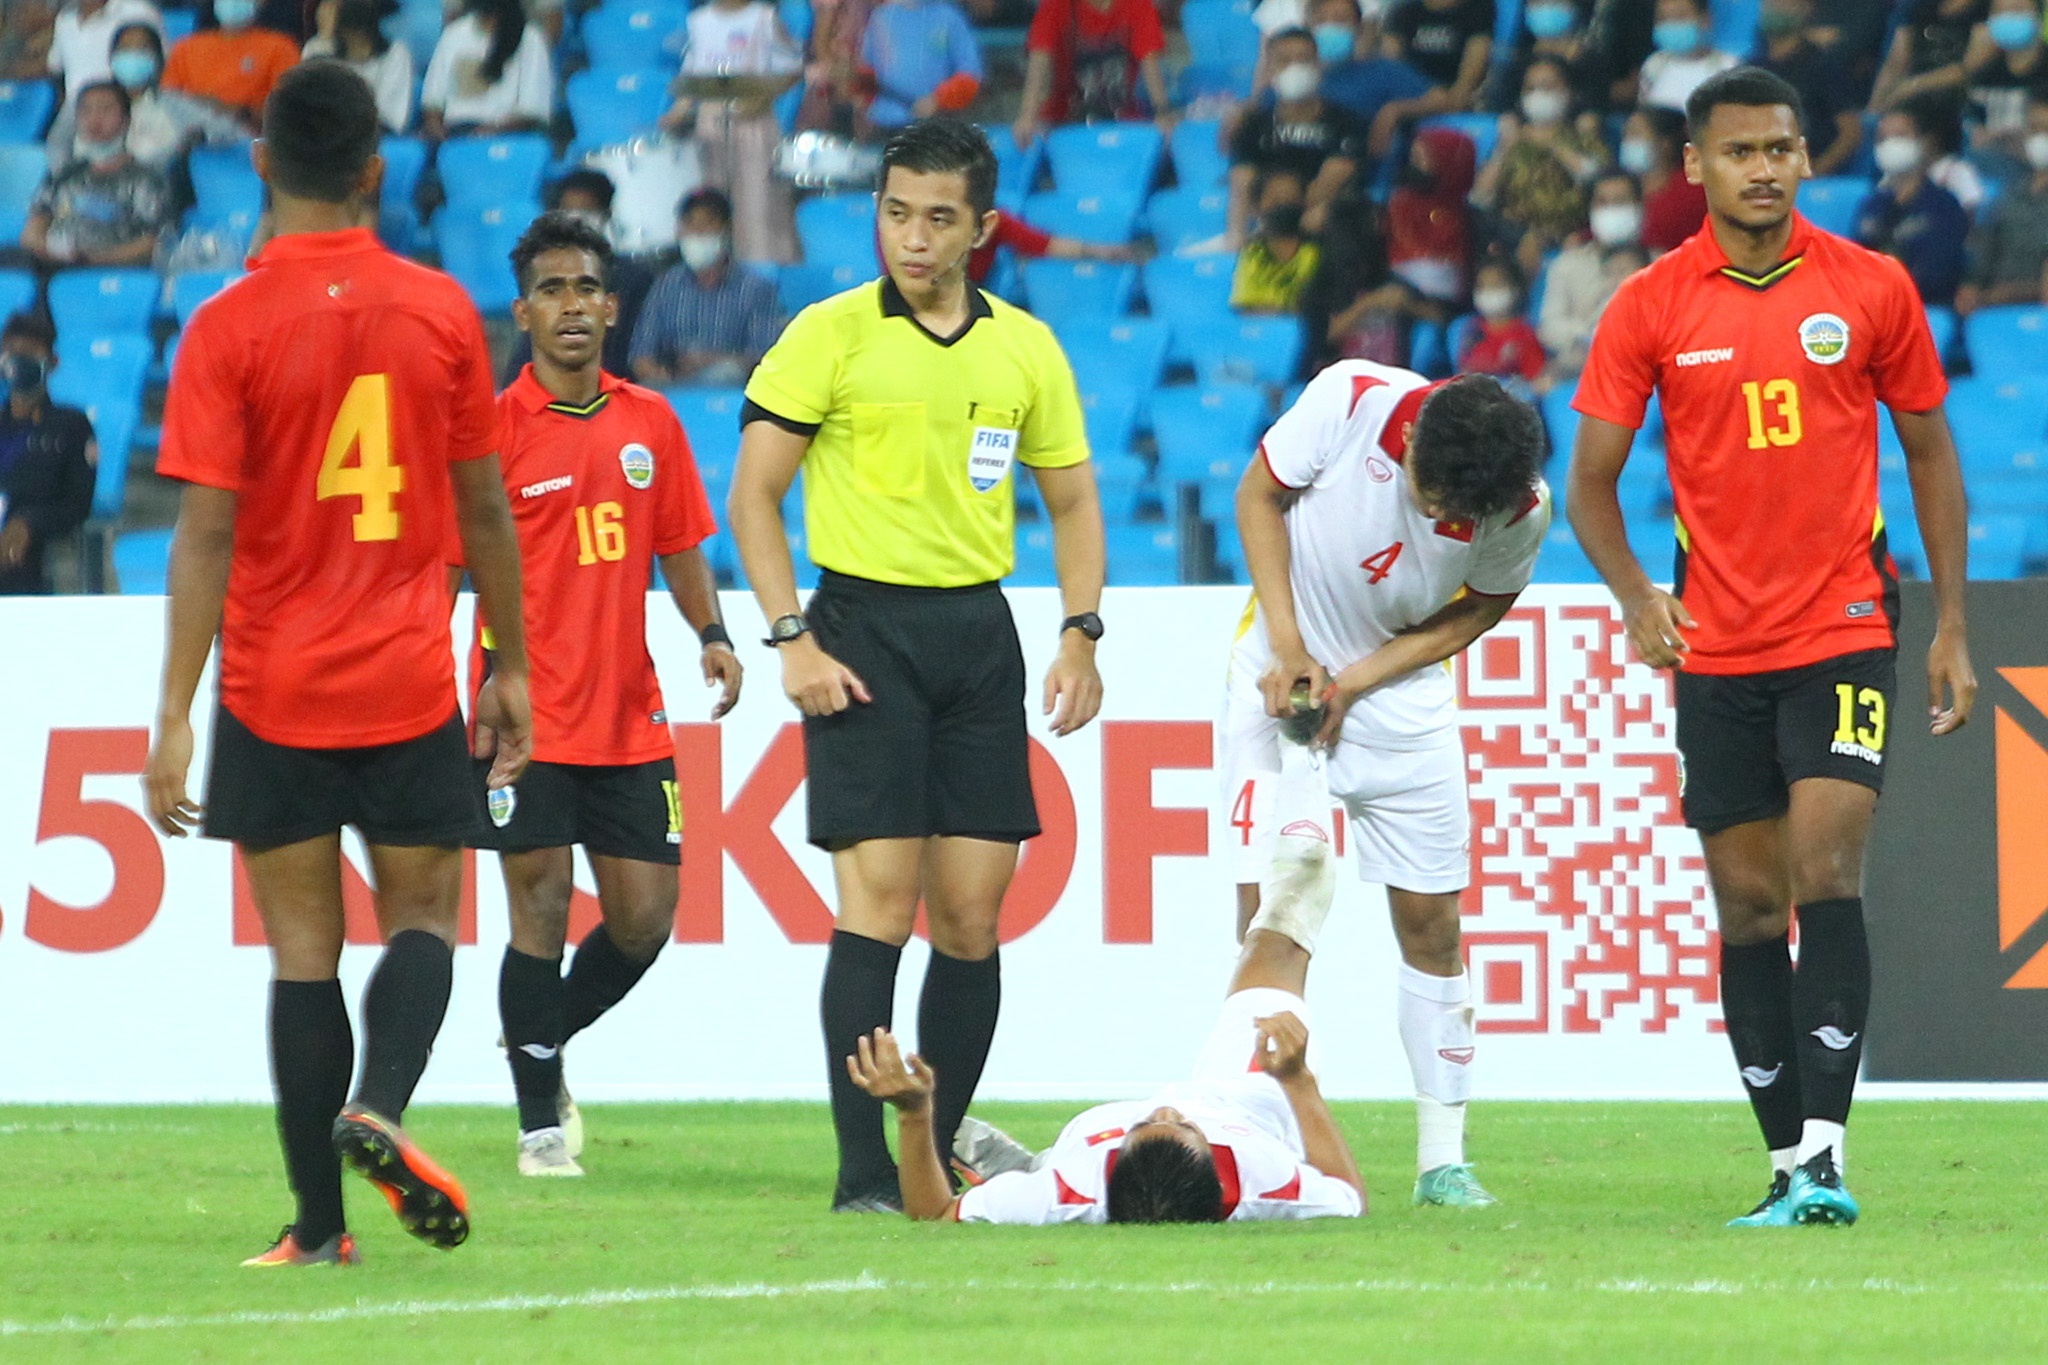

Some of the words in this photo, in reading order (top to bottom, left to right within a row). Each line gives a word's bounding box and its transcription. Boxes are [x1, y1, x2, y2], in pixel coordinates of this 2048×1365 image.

[1676, 347, 1734, 367] narrow
[976, 431, 1009, 449] FIFA
[1741, 379, 1803, 450] 13
[316, 373, 403, 542] 4
[971, 456, 1006, 468] REFEREE
[521, 475, 573, 499] narrow
[575, 501, 626, 566] 16
[1360, 541, 1404, 585] 4
[1834, 683, 1886, 752] 13
[1830, 741, 1882, 766] narrow
[1231, 779, 1256, 846] 4
[0, 727, 165, 953] 5
